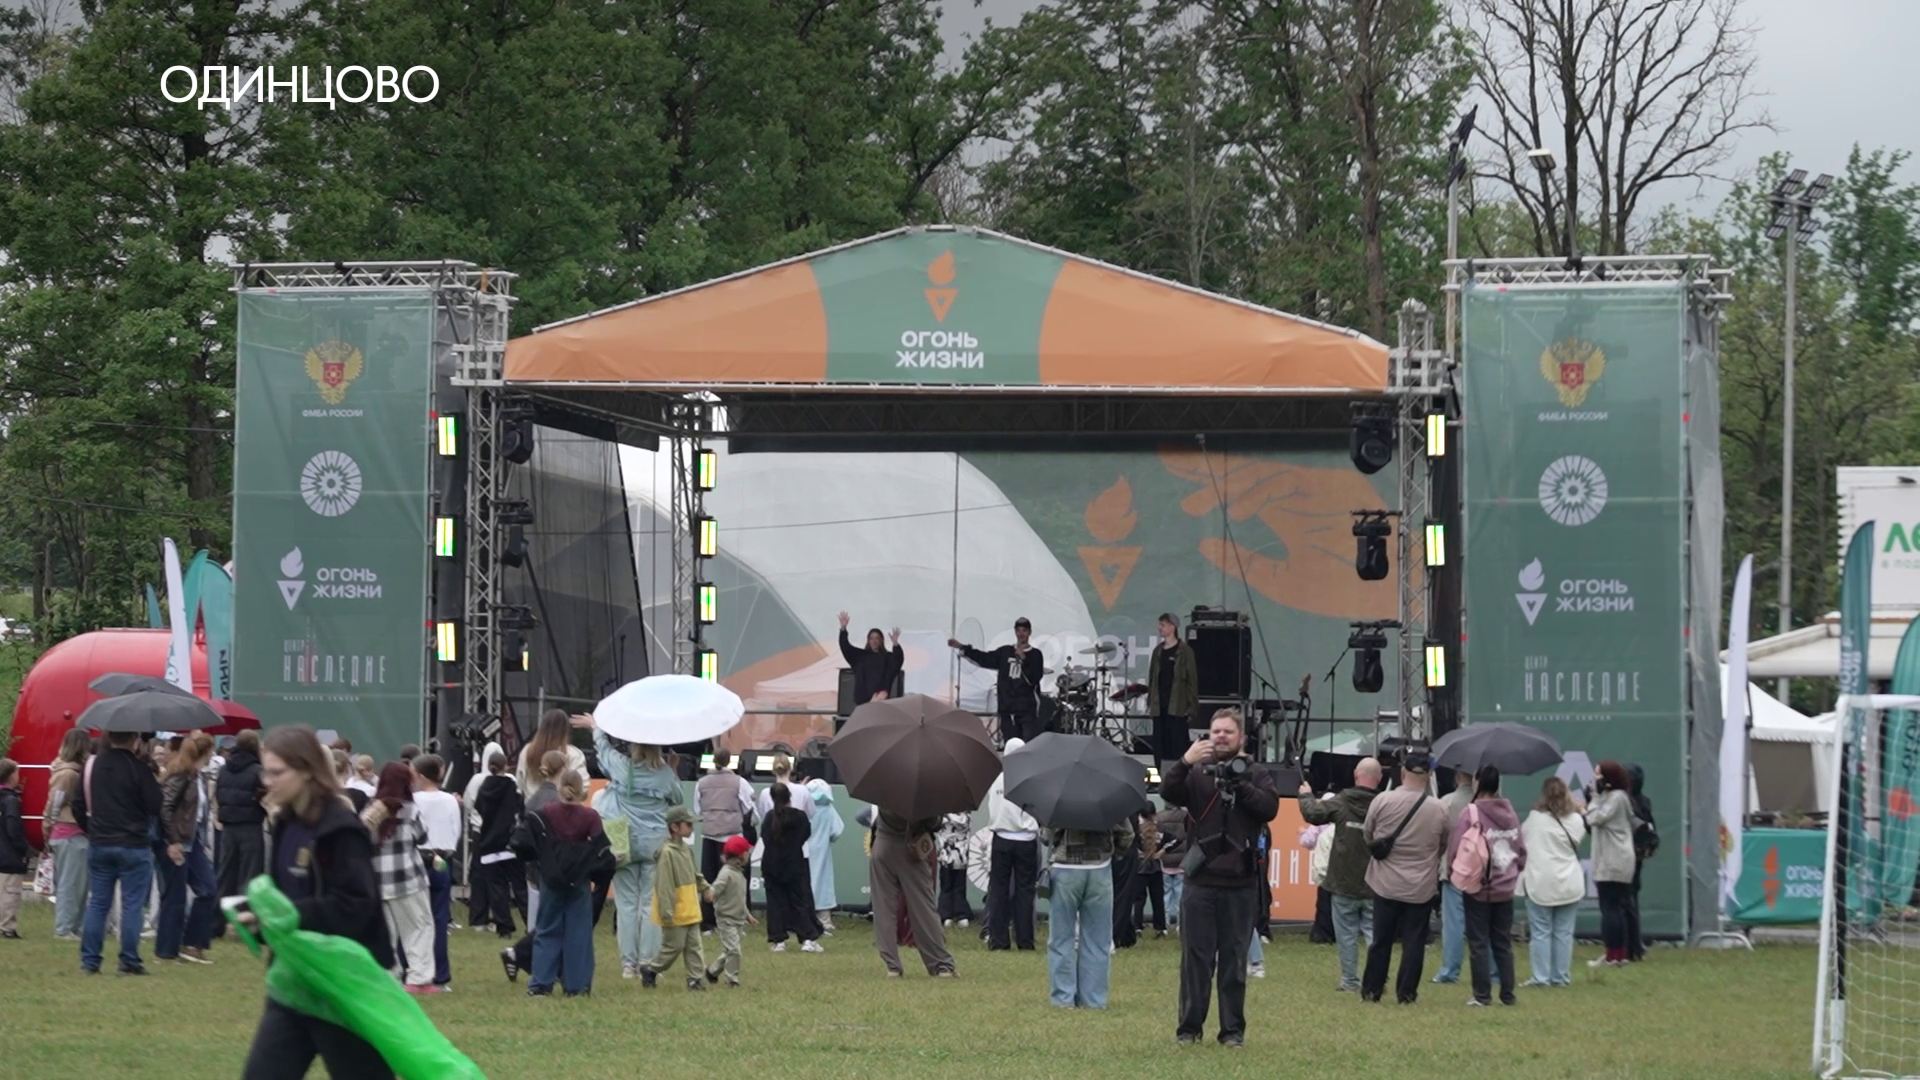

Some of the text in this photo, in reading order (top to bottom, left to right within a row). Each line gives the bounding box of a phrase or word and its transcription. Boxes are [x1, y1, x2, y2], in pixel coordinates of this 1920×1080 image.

[901, 330, 978, 348] ОГОНЬ
[895, 350, 984, 368] ЖИЗНИ
[329, 409, 363, 418] РОССИИ
[1569, 411, 1608, 420] РОССИИ
[316, 567, 377, 582] ОГОНЬ
[312, 584, 382, 598] ЖИЗНИ
[1560, 579, 1628, 594] ОГОНЬ
[1555, 596, 1634, 612] ЖИЗНИ
[283, 655, 386, 686] НАСЛЕДИЕ
[1525, 656, 1548, 670] ЦЕНТР
[1525, 672, 1640, 705] НАСЛЕДИЕ
